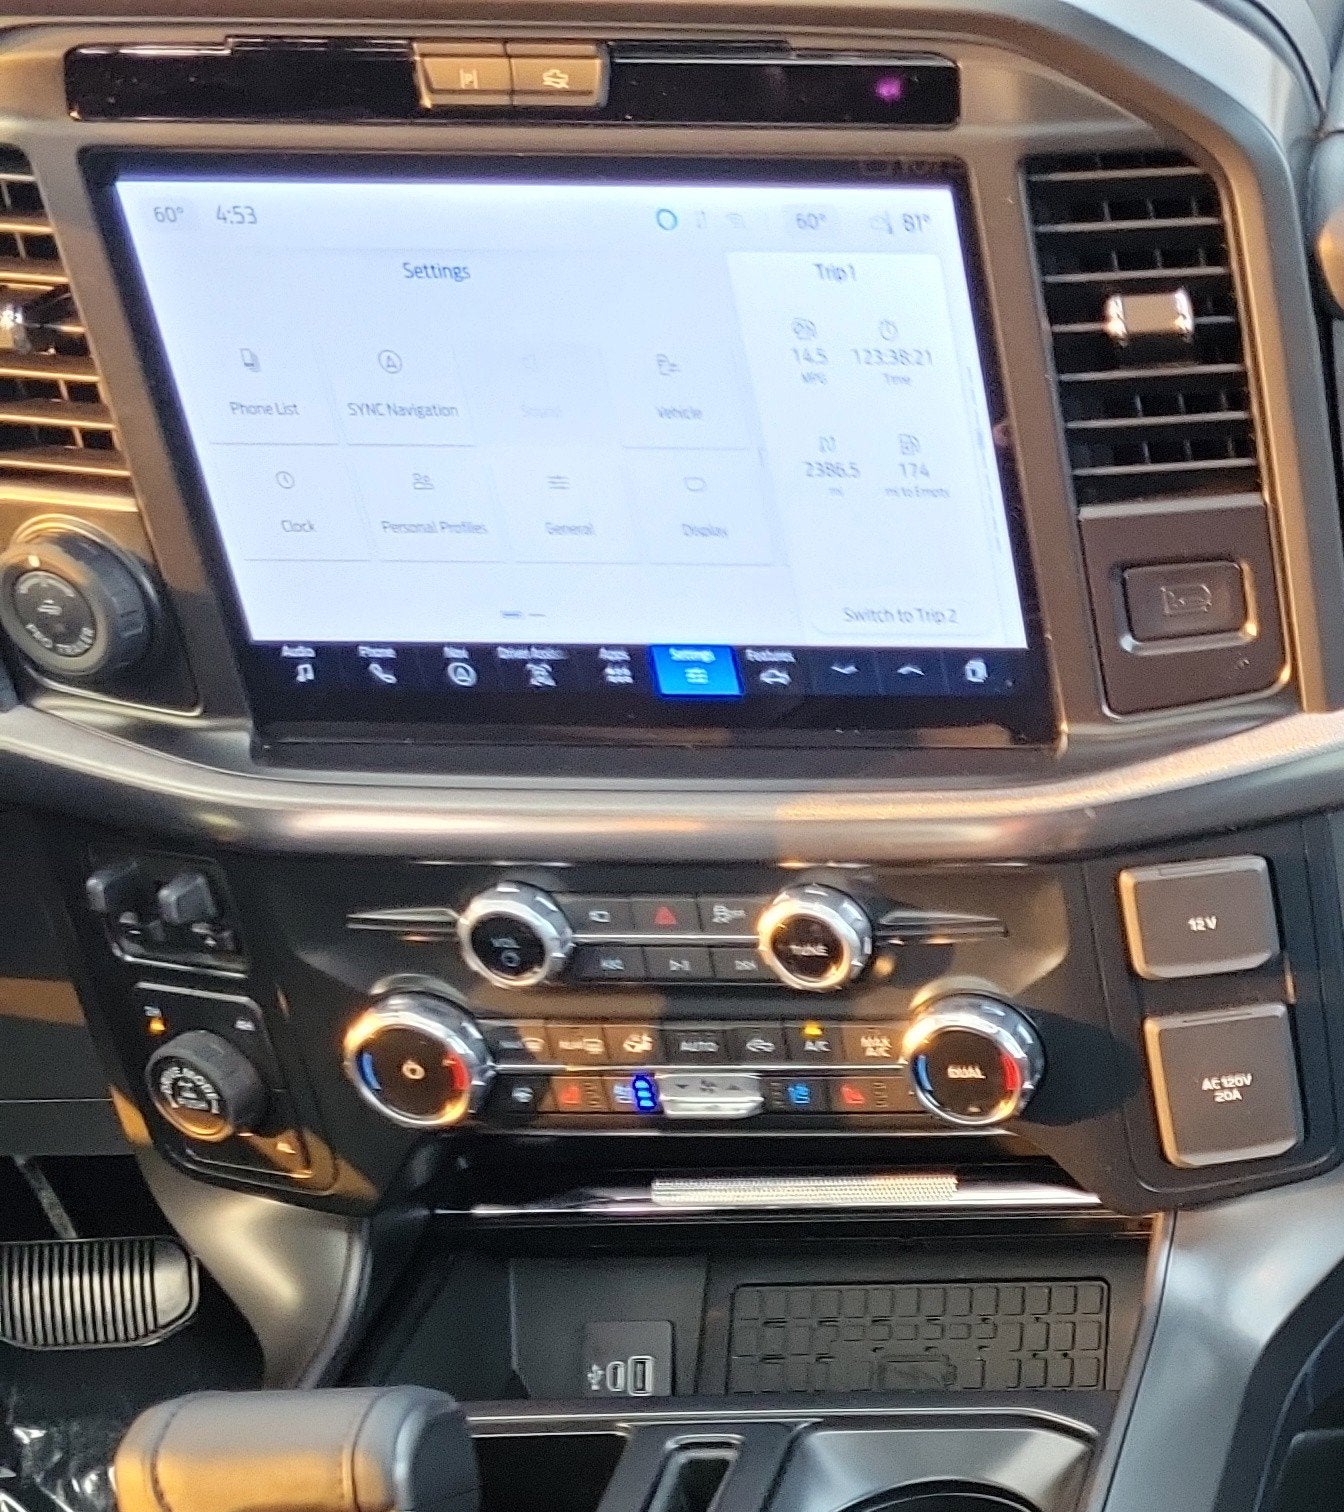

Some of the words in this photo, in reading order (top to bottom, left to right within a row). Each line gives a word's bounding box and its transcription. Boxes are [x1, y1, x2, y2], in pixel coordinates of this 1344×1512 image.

[214, 204, 259, 226] 4:53
[402, 261, 472, 283] Settings
[229, 400, 274, 417] Phone
[274, 400, 301, 417] List
[346, 401, 386, 417] SYNC
[385, 401, 460, 420] Navigation
[946, 1064, 987, 1080] DUAL
